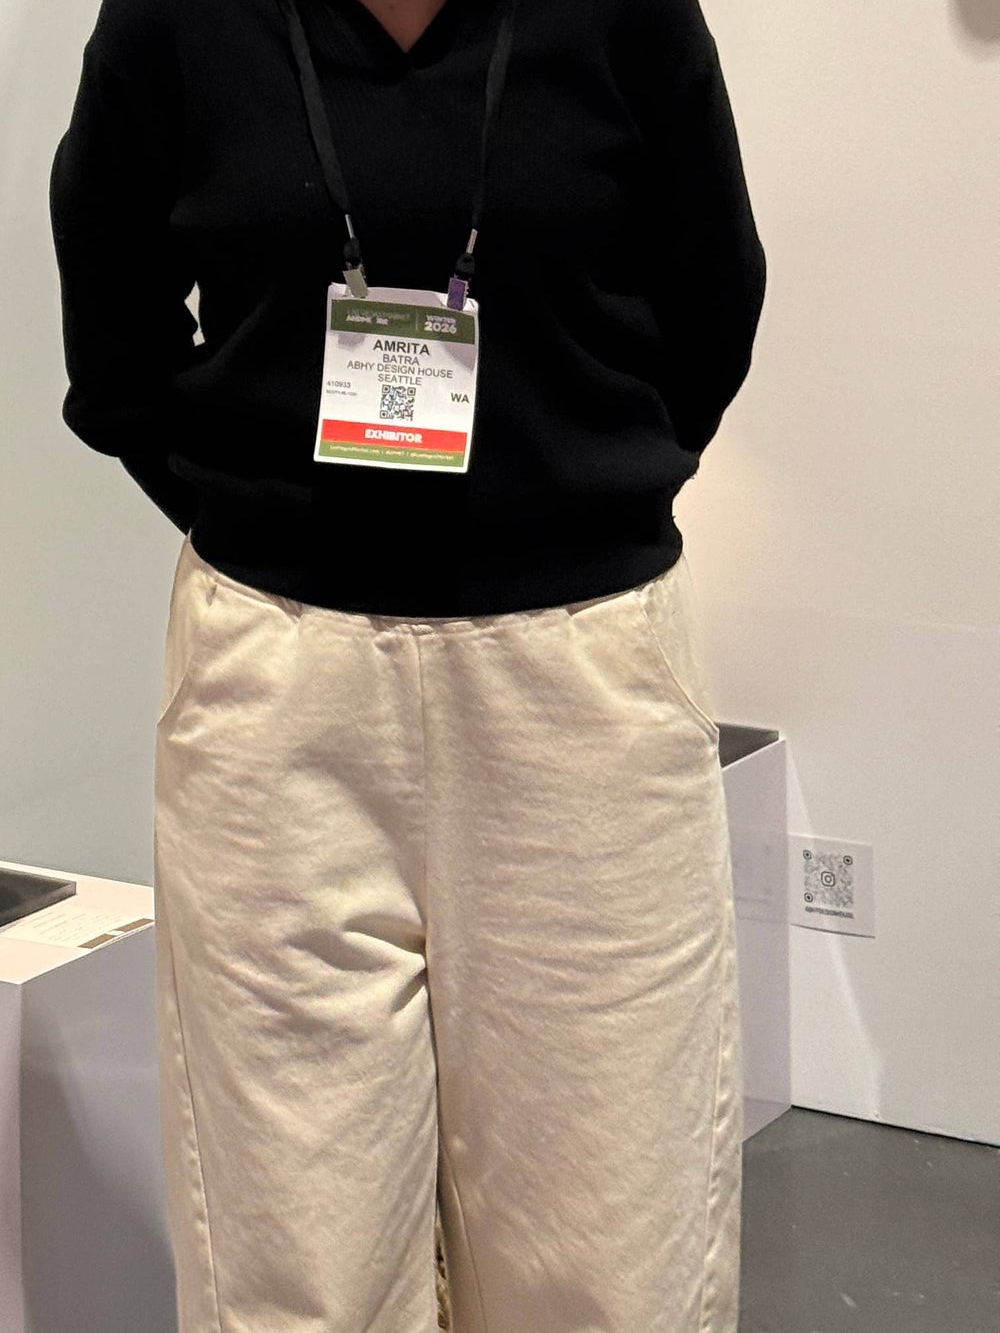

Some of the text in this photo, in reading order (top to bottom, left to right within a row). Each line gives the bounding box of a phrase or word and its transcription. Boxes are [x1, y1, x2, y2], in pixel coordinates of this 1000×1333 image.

[424, 321, 457, 334] 2026
[373, 339, 431, 356] AMRITA
[382, 354, 420, 366] BATRA
[346, 360, 453, 379] ABHY DESIGN HOUSE
[377, 373, 422, 385] SEATTLE
[450, 392, 470, 404] WA
[364, 428, 423, 444] EXHIBITOR
